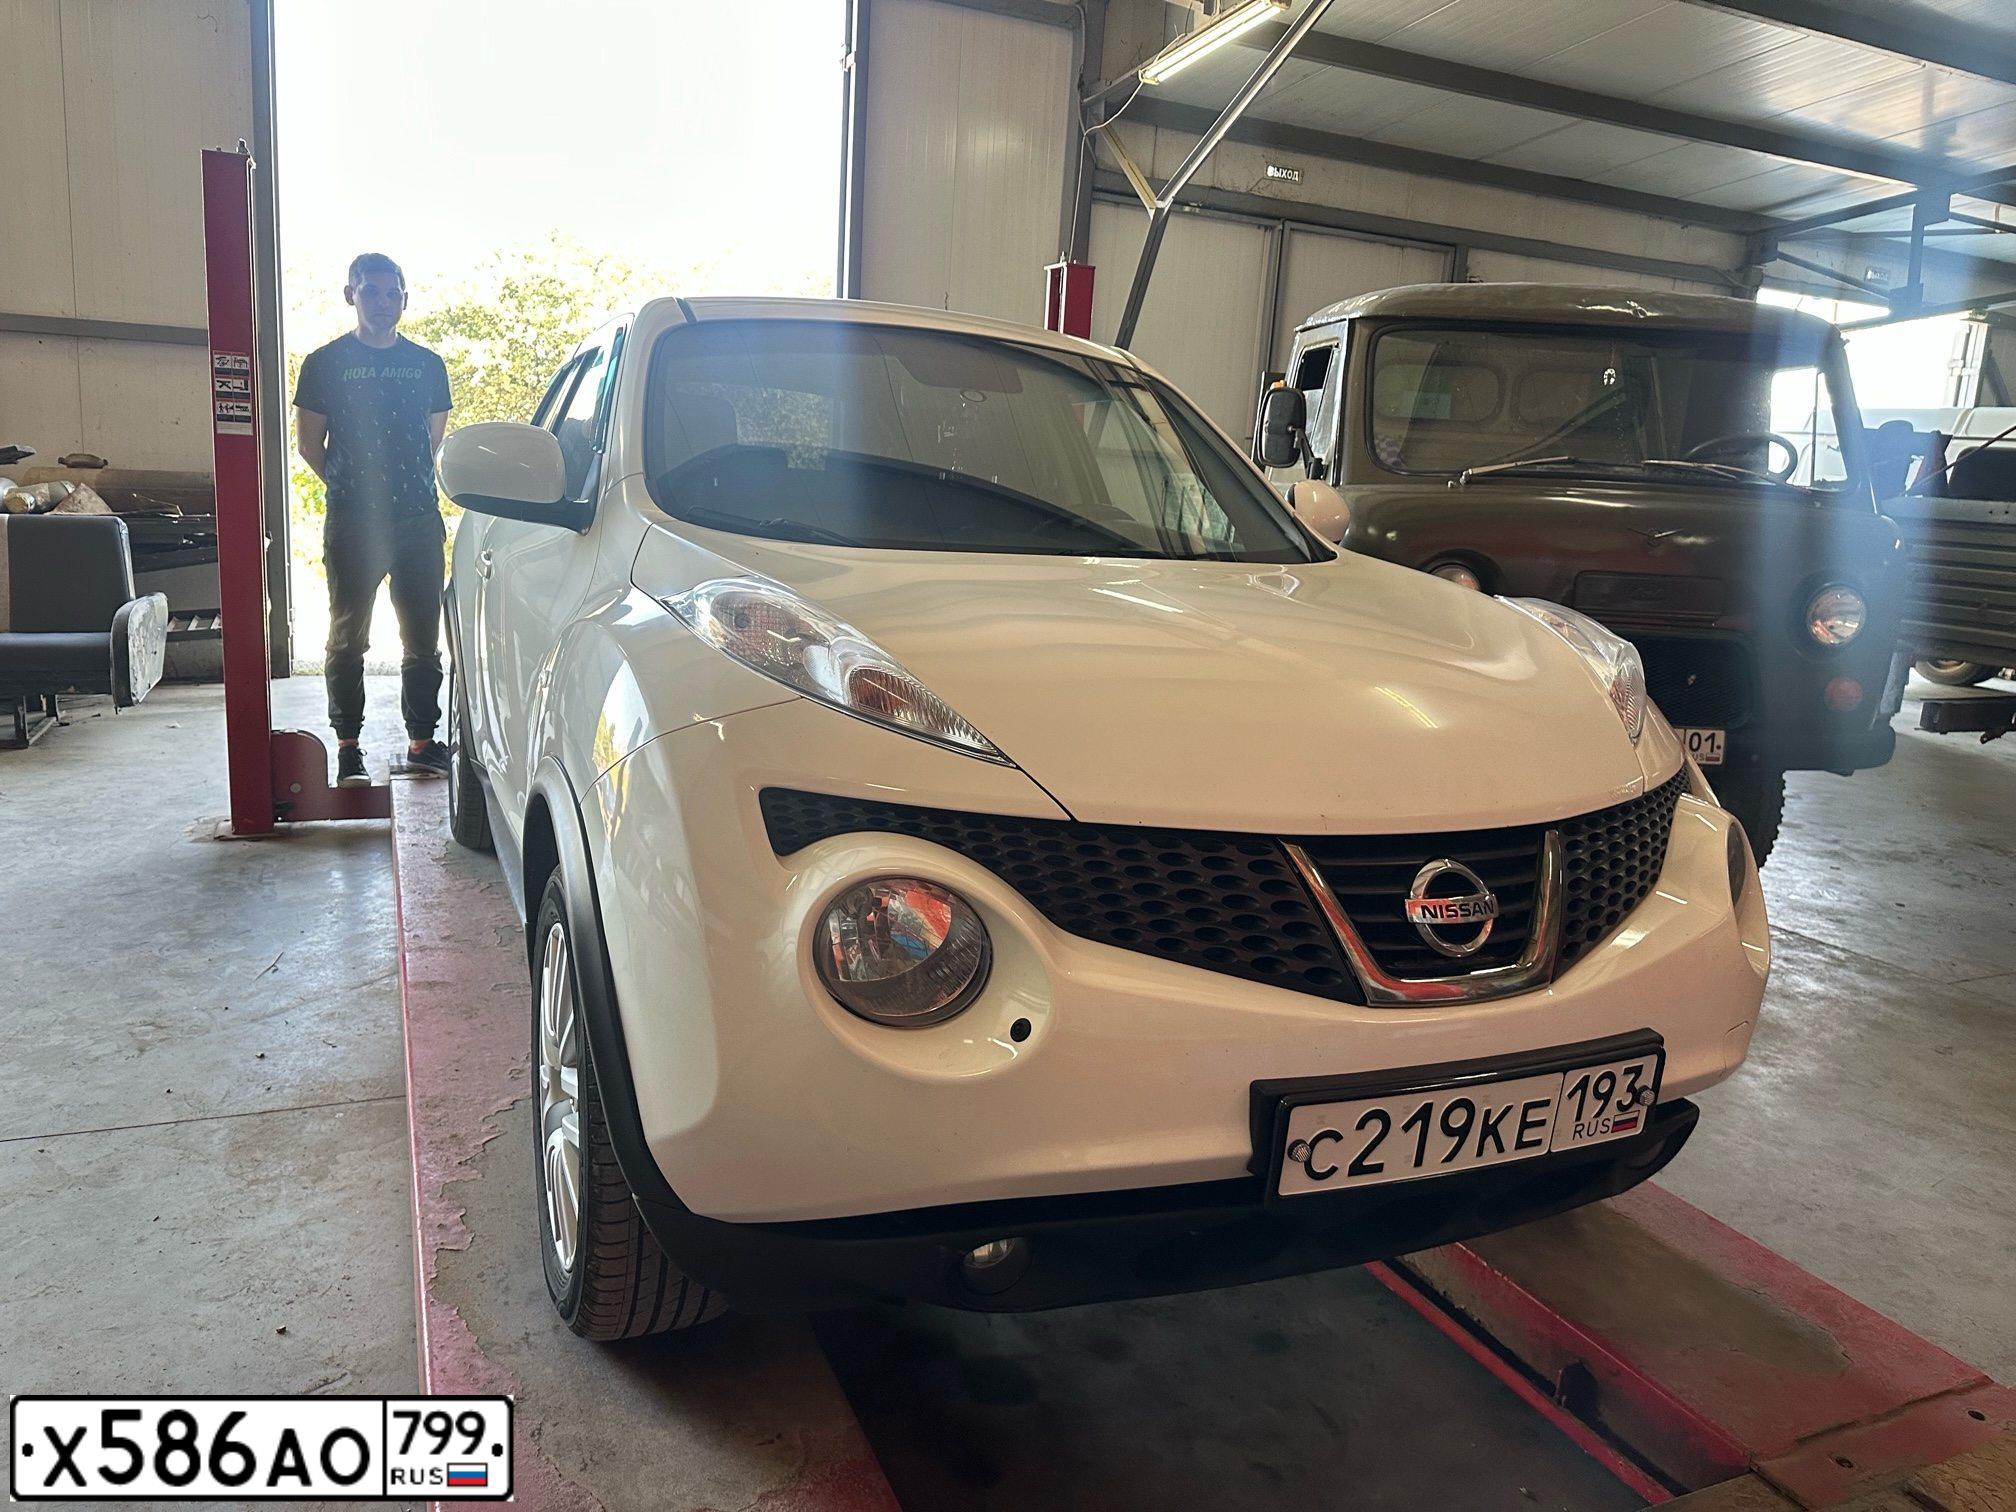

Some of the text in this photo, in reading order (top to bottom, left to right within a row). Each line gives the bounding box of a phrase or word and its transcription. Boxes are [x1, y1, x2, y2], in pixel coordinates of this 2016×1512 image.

[381, 366, 422, 379] AMIGO
[1689, 732, 1715, 753] 01
[1420, 900, 1494, 919] NISSAN
[1565, 1064, 1644, 1123] 193
[1571, 1116, 1612, 1141] RUS
